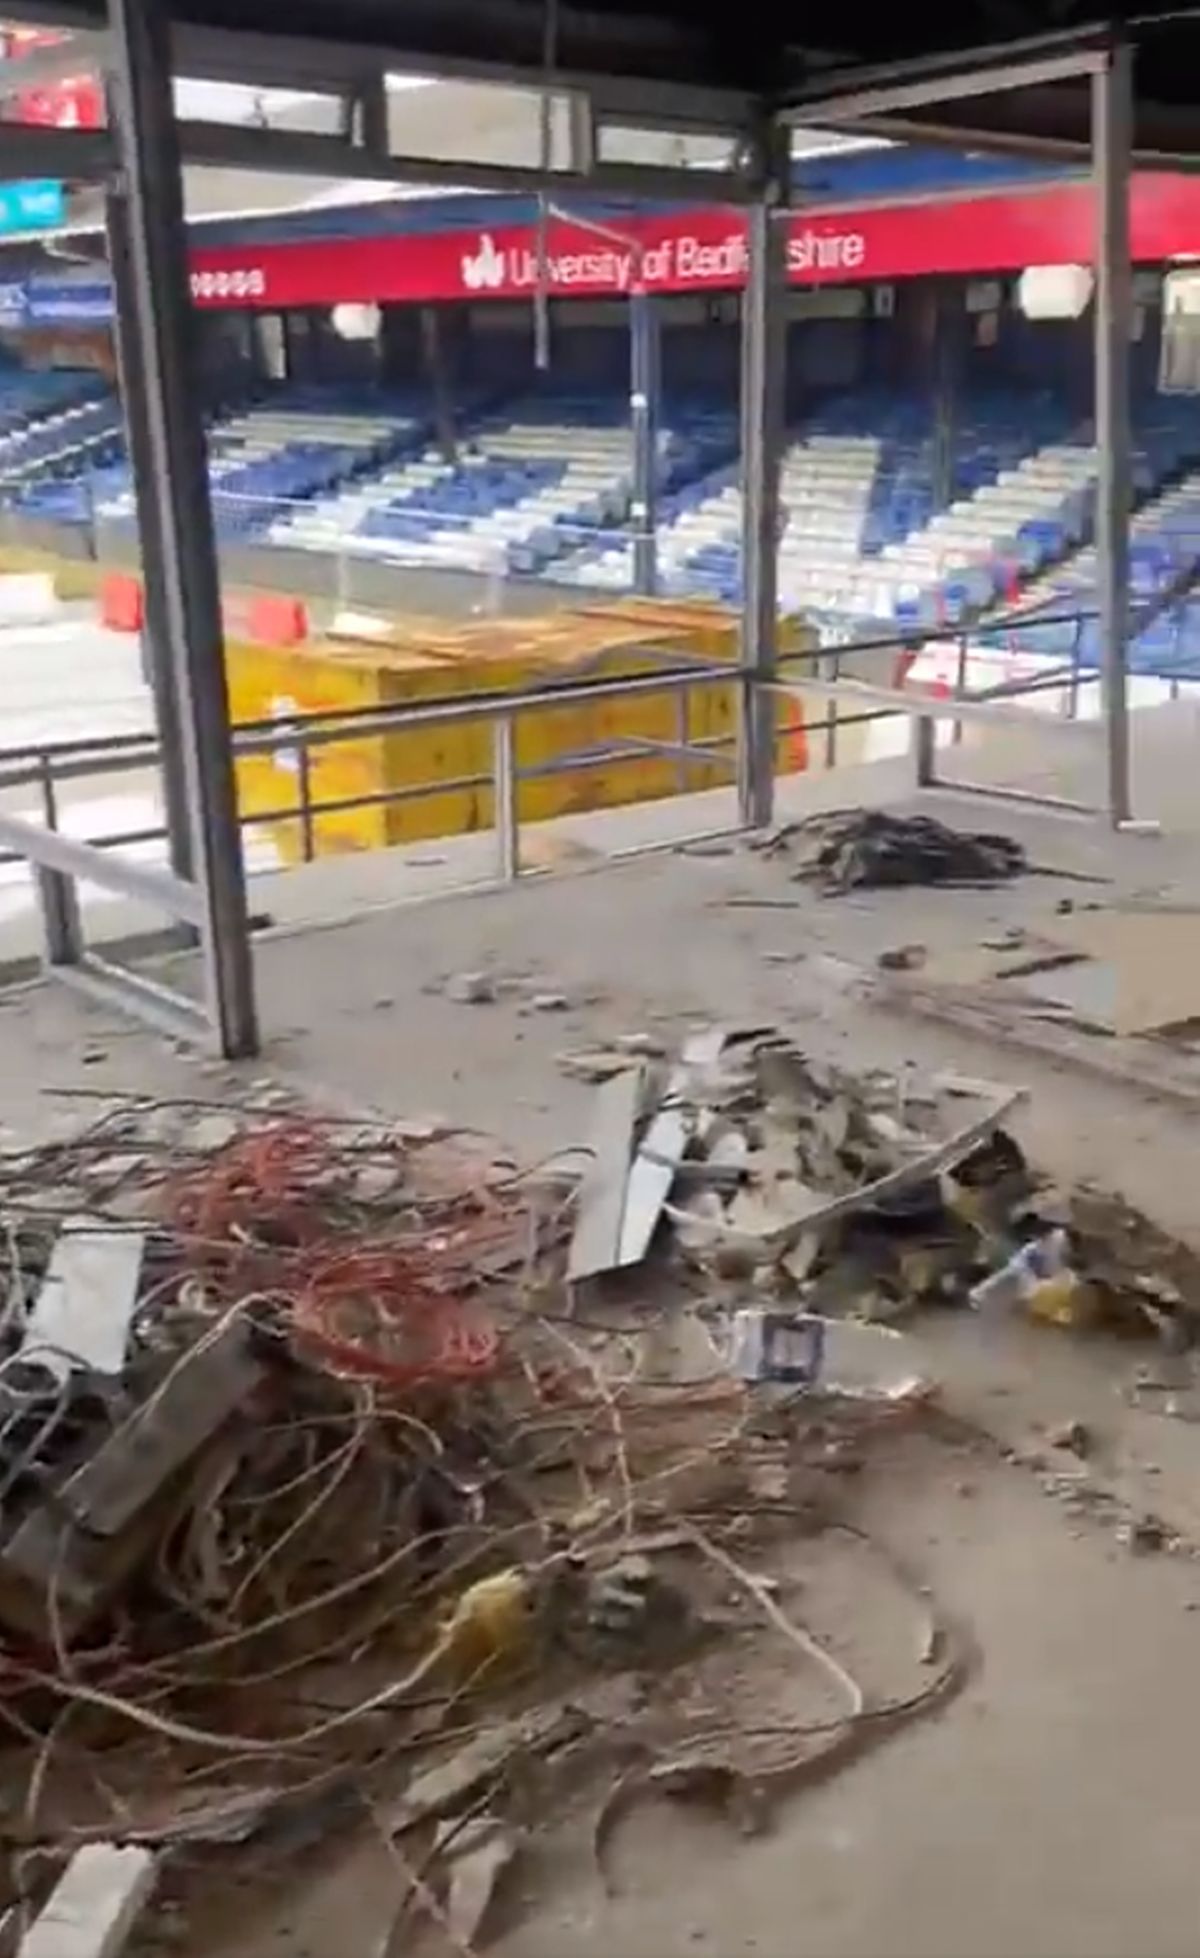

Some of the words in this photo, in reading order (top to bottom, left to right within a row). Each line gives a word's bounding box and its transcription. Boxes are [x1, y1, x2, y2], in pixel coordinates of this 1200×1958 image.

[509, 247, 631, 291] Unversity
[642, 239, 673, 280] of
[677, 229, 865, 278] Bedfshire
